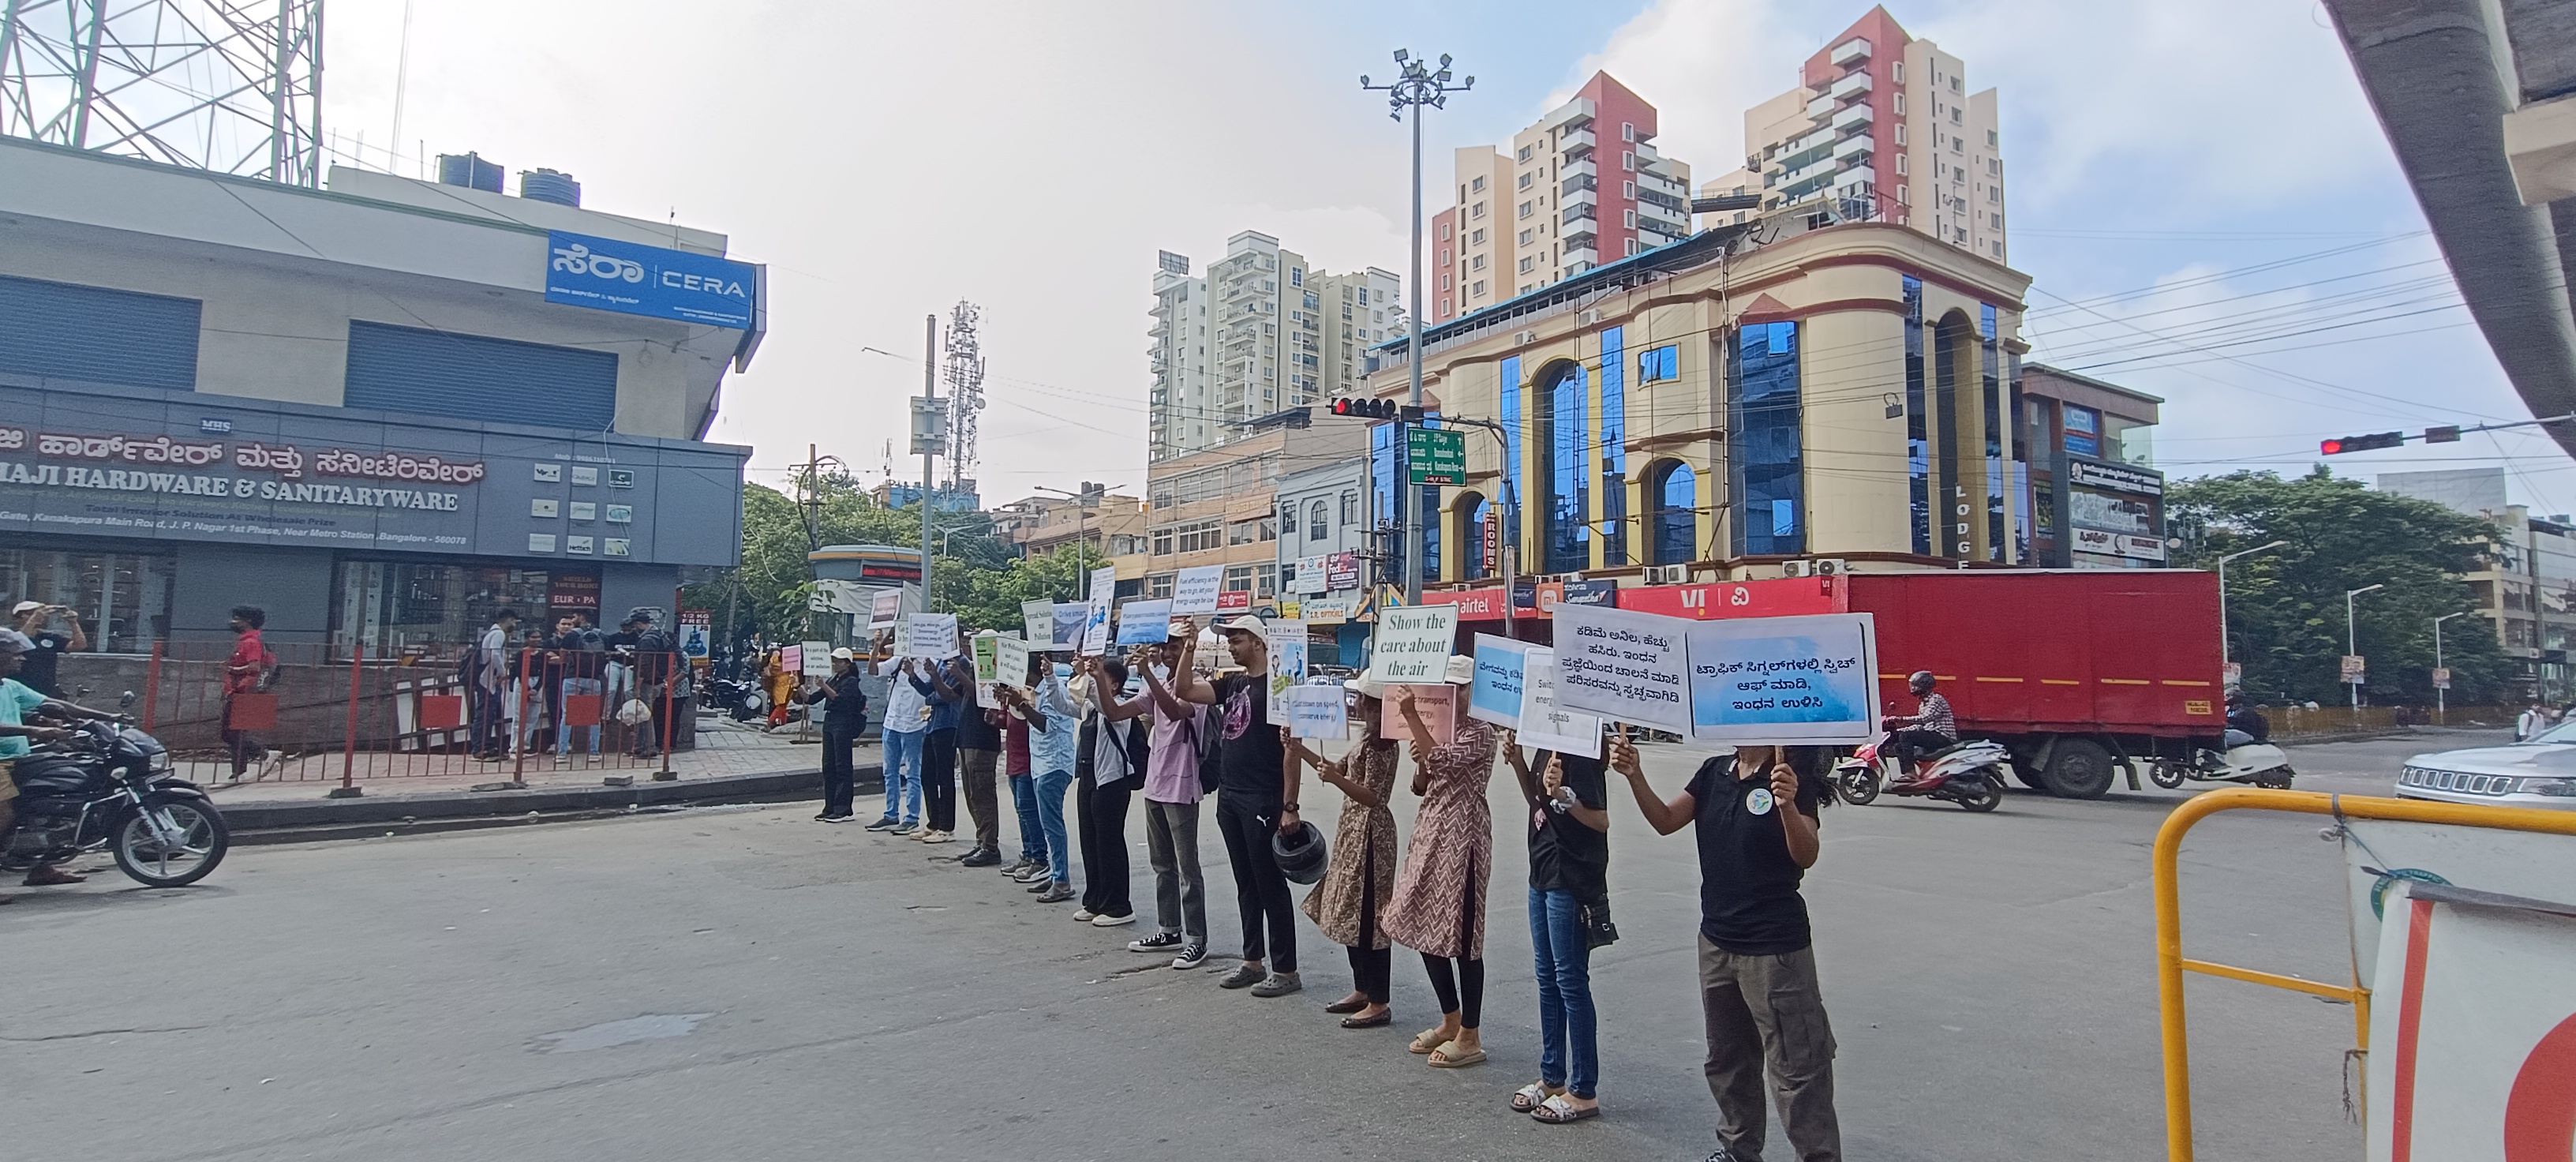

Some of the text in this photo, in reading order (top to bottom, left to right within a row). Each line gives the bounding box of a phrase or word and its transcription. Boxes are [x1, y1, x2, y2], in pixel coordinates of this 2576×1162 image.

[553, 244, 645, 283] ಸೆರಾ
[662, 271, 746, 298] CERA
[237, 444, 303, 478] ಮತ್ತು
[65, 467, 229, 497] HARDWARE
[234, 478, 256, 497] &
[260, 481, 459, 512] SANITARYWARE
[84, 504, 118, 513] Total
[172, 510, 224, 519] Solution
[307, 518, 337, 527] Prize
[193, 523, 227, 533] Nagar
[247, 526, 282, 536] Phase,
[340, 530, 375, 539] Station
[434, 536, 466, 545] 560078
[1956, 485, 1971, 570] LODGE
[1487, 522, 1496, 565] ROOMS
[1188, 576, 1207, 585] efficiency
[1460, 597, 1489, 614] airtel
[1731, 587, 1750, 606] ವಿ
[1388, 613, 1446, 631] Show the
[1380, 637, 1447, 654] care about
[1577, 626, 1670, 653] ಕಡಿಮೆ ಅನಿಲ, ಹೆಚ್ಚು
[1588, 644, 1657, 664] ಹಸಿರು. ಇಂಧನ
[1387, 660, 1428, 677] the air
[1562, 657, 1679, 685] ಪ್ರಜ್ಞೆಯಿಂದ ಚಾಲನೆ ಮಾಡಿ
[1696, 662, 1743, 678] ಟ್ರಾಫಿಕ್
[1823, 657, 1855, 674] ಸ್ವಿಚ್
[1537, 679, 1554, 688] Switc
[1566, 674, 1622, 697] ಪರಿಸರವನ್ನು
[1737, 677, 1811, 692] ಆಫ್ ಮಾಡಿ,
[1417, 696, 1450, 707] transport,
[1535, 697, 1554, 707] energ
[1732, 695, 1823, 710] ಇಂಧನ ಉಳಿಸಿ
[1548, 712, 1570, 723] signals
